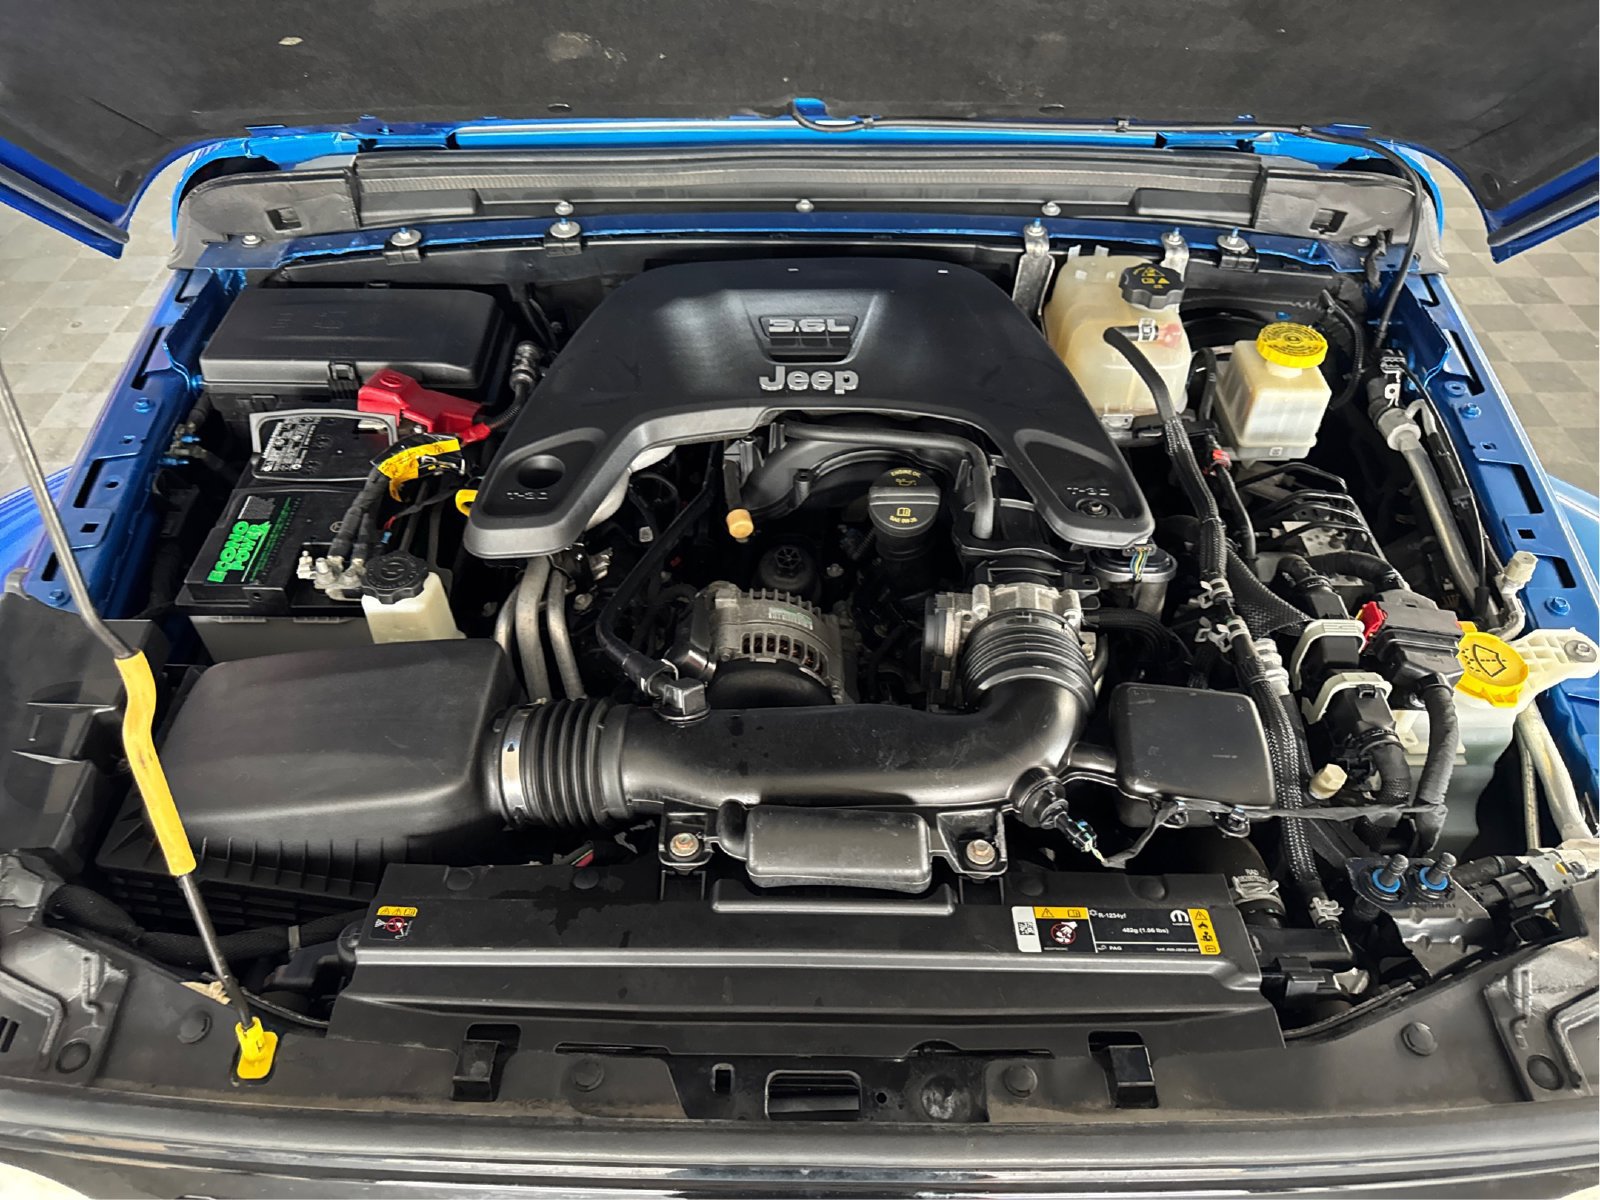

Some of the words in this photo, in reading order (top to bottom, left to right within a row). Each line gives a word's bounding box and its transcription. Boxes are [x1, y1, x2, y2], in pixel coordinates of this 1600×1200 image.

[768, 318, 851, 333] 3.6L
[759, 365, 859, 395] Jeep
[207, 520, 249, 582] ECONO
[230, 521, 272, 571] POWER
